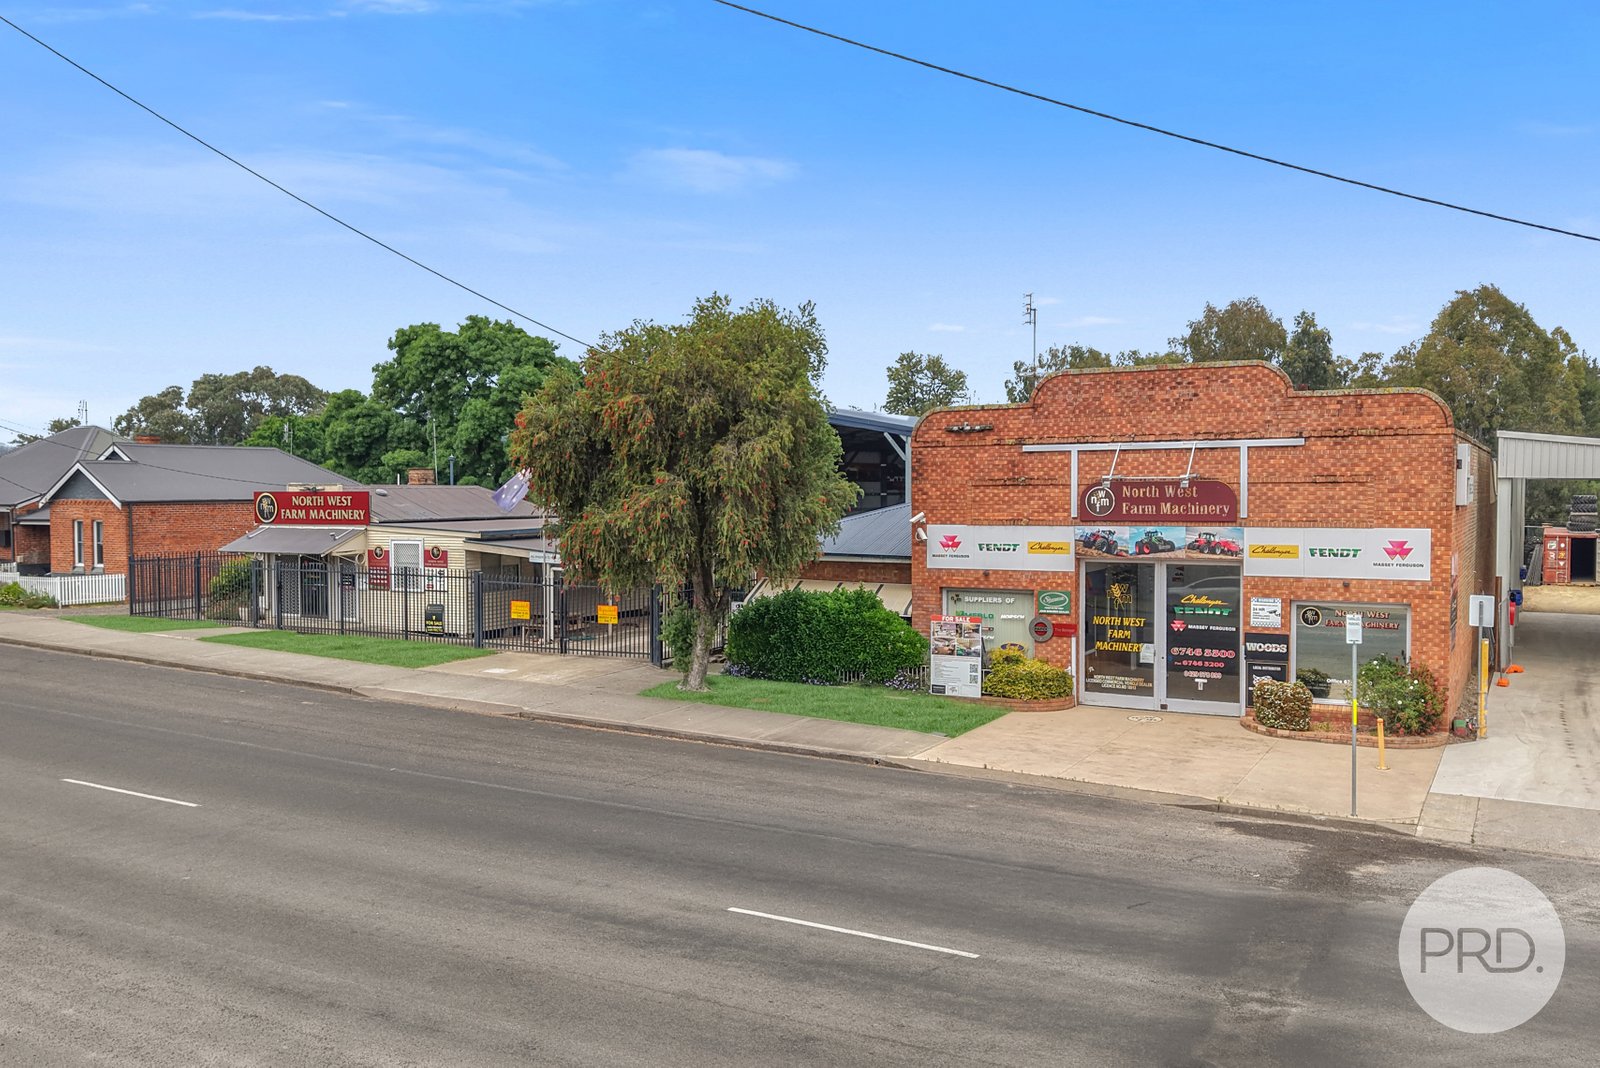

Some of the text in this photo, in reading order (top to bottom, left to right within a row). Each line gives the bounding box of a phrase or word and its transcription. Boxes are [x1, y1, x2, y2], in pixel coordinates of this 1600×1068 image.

[1122, 485, 1198, 498] North West
[292, 496, 352, 506] NORTH WEST
[1122, 502, 1230, 516] Farm Machinery
[281, 509, 365, 520] FARM MACHINERY
[978, 544, 1020, 552] FENDT
[1252, 546, 1296, 556] Challenger
[1308, 548, 1362, 558] FENDT
[1174, 607, 1232, 615] FENDT
[1368, 611, 1390, 619] WEST
[1093, 616, 1145, 627] NORTH WEST
[1108, 630, 1131, 639] FARM
[1096, 641, 1143, 652] MACHINERY
[1171, 647, 1202, 656] 6746
[1246, 642, 1287, 653] WOODS
